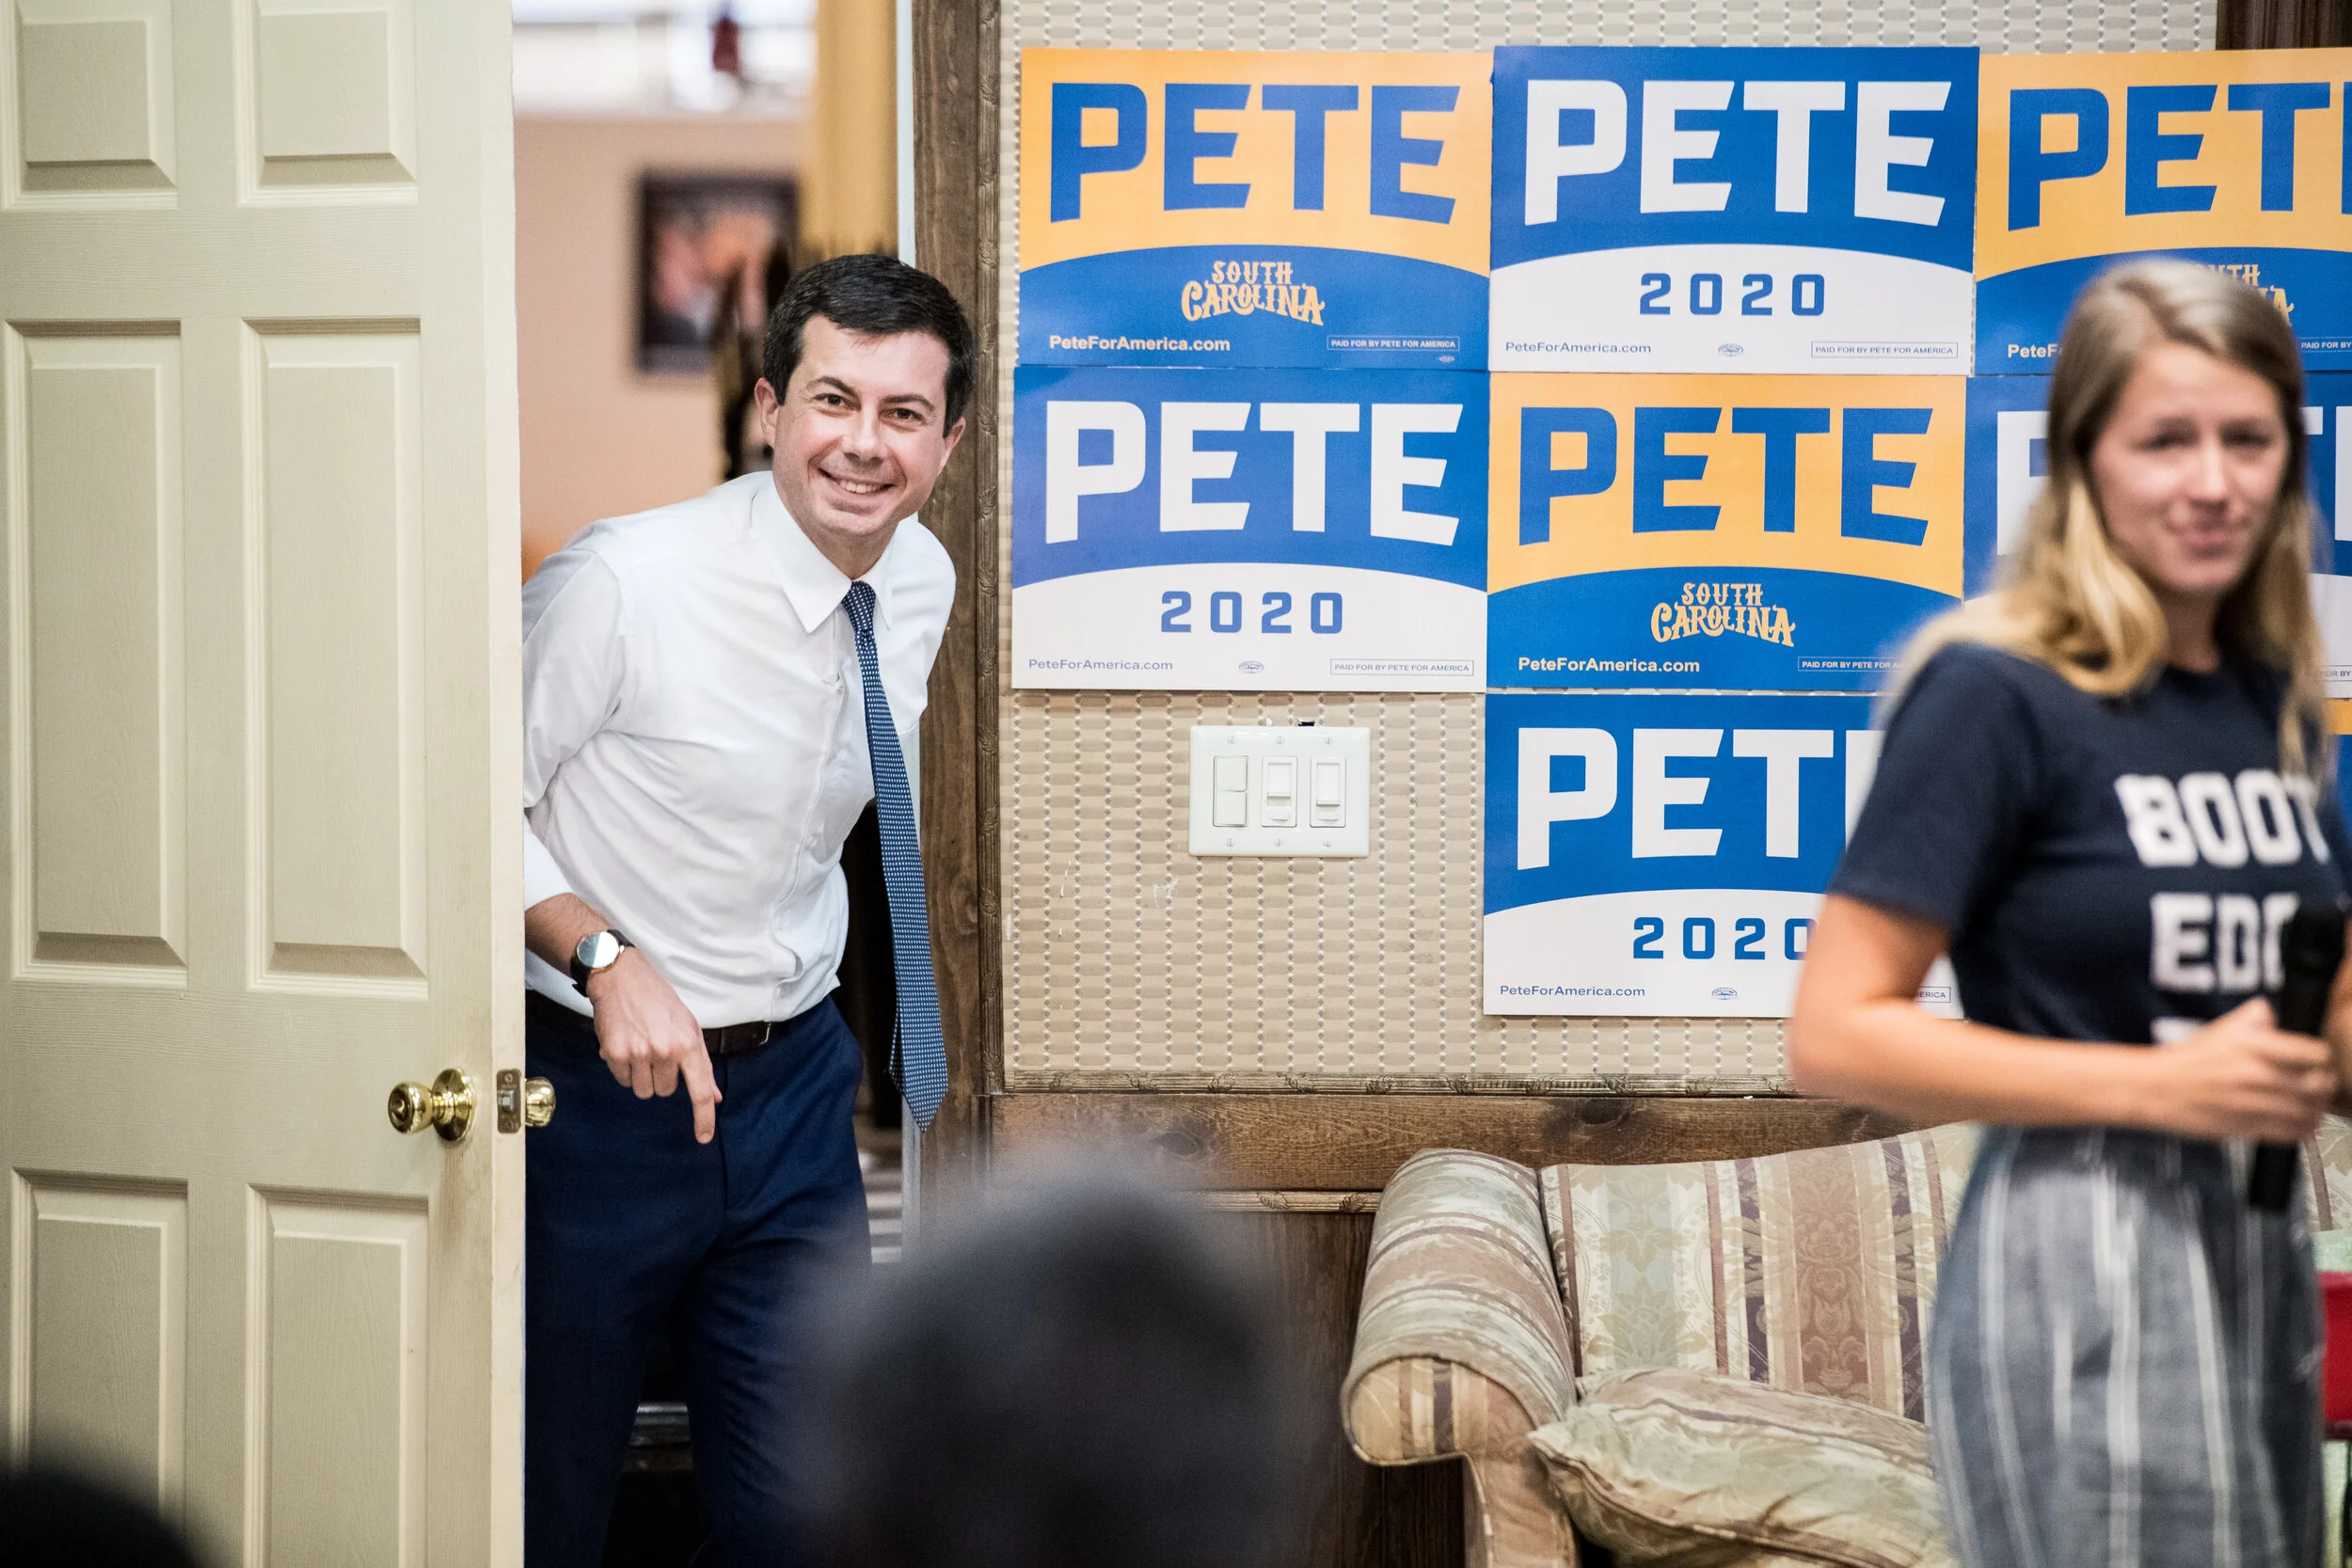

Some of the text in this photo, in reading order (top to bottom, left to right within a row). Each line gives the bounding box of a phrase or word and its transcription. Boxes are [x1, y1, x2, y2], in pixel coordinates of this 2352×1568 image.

[1050, 82, 1461, 225] PETE
[1524, 79, 1952, 228] PETE
[2008, 81, 2352, 232] PET
[1211, 260, 1294, 285] SOUTH
[1181, 279, 1326, 326] CAROLINA
[1639, 273, 1825, 317] 2020
[1049, 335, 1231, 351] PeteForAmerica.com
[1505, 341, 1651, 353] PeteForAmerica.com
[1914, 346, 1953, 355] AMERICA
[1045, 400, 1464, 546] PETE
[1518, 406, 1933, 547] PETE
[1160, 591, 1343, 634] 2020
[1681, 582, 1764, 607] SOUTH
[1650, 601, 1796, 648] CAROLINA
[1028, 658, 1173, 670] PeteForAmerica.com
[1518, 657, 1700, 673] PeteForAmerica.com
[1633, 916, 1817, 960] 2020
[1500, 985, 1645, 996] PeteForAmerica.com
